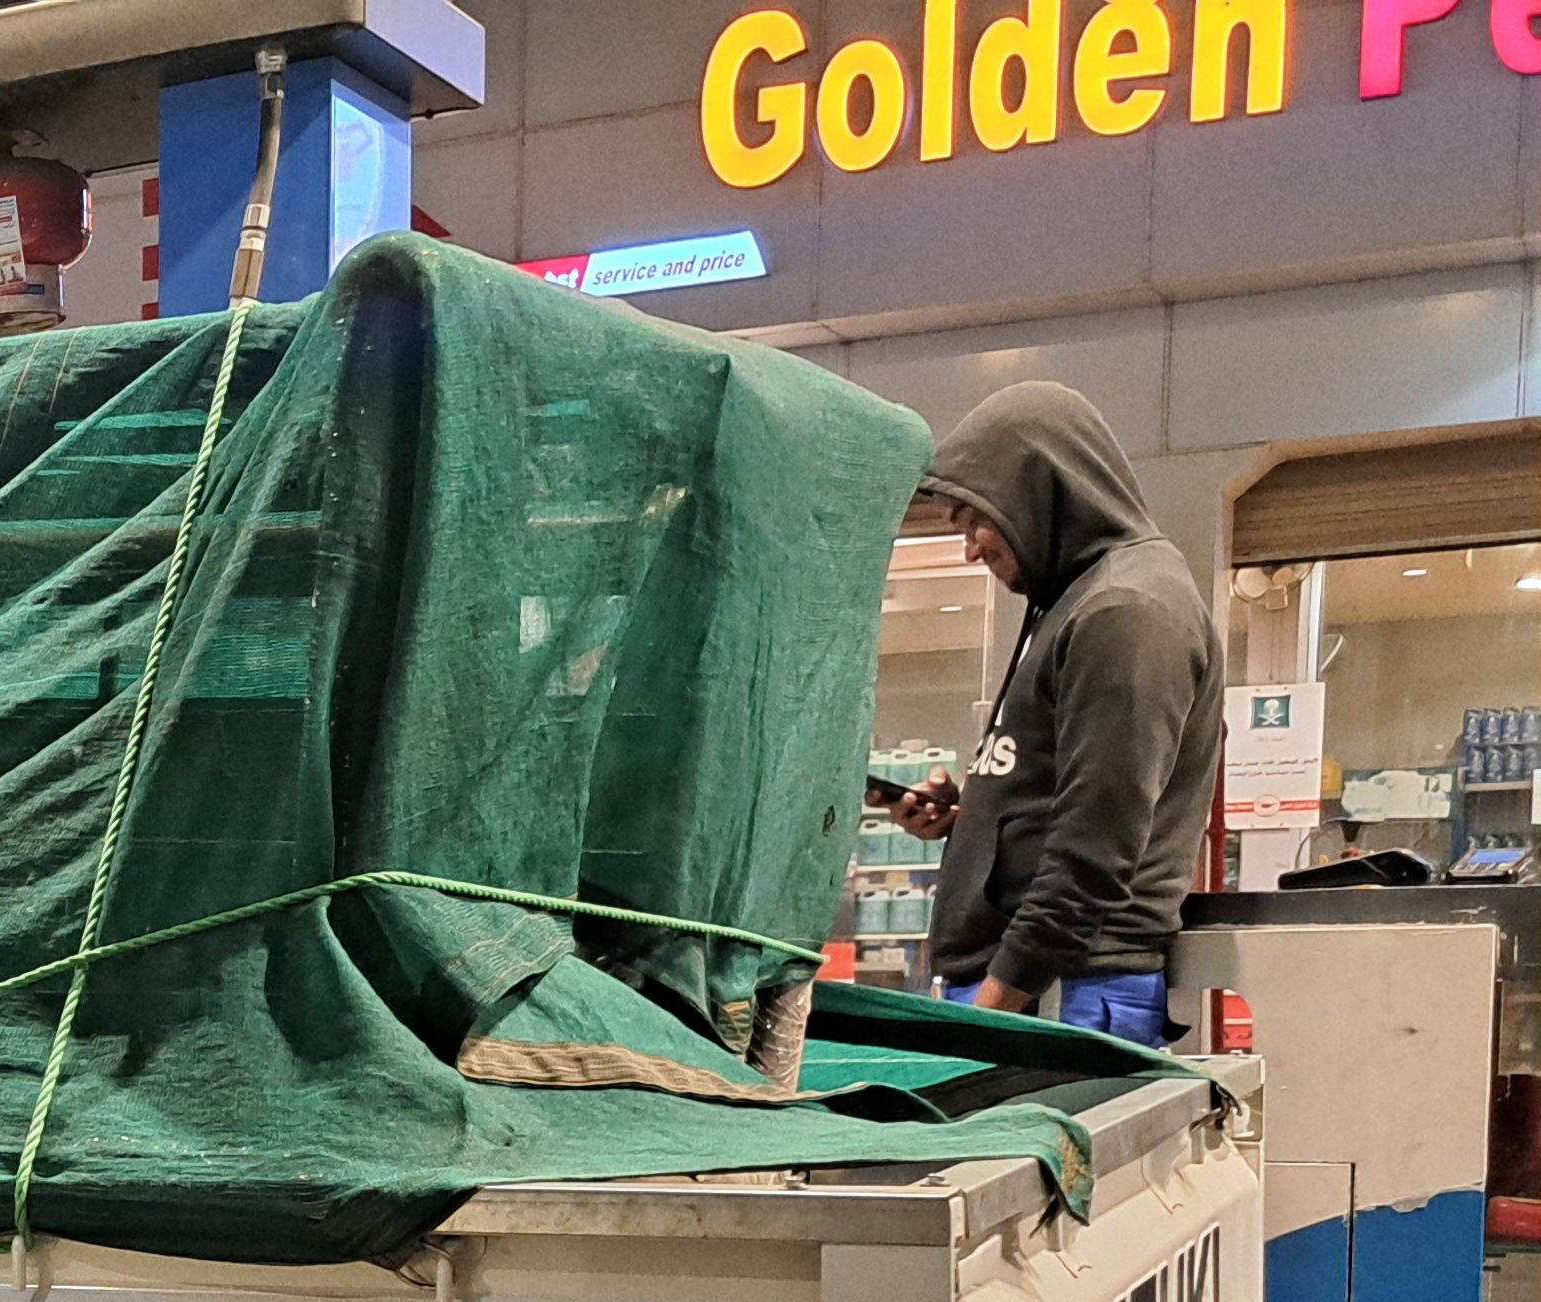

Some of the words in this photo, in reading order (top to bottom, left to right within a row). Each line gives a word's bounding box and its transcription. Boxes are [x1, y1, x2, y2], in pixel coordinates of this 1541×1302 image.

[700, 0, 1289, 190] Golden
[592, 262, 657, 286] service
[661, 253, 695, 276] and
[698, 249, 746, 277] price
